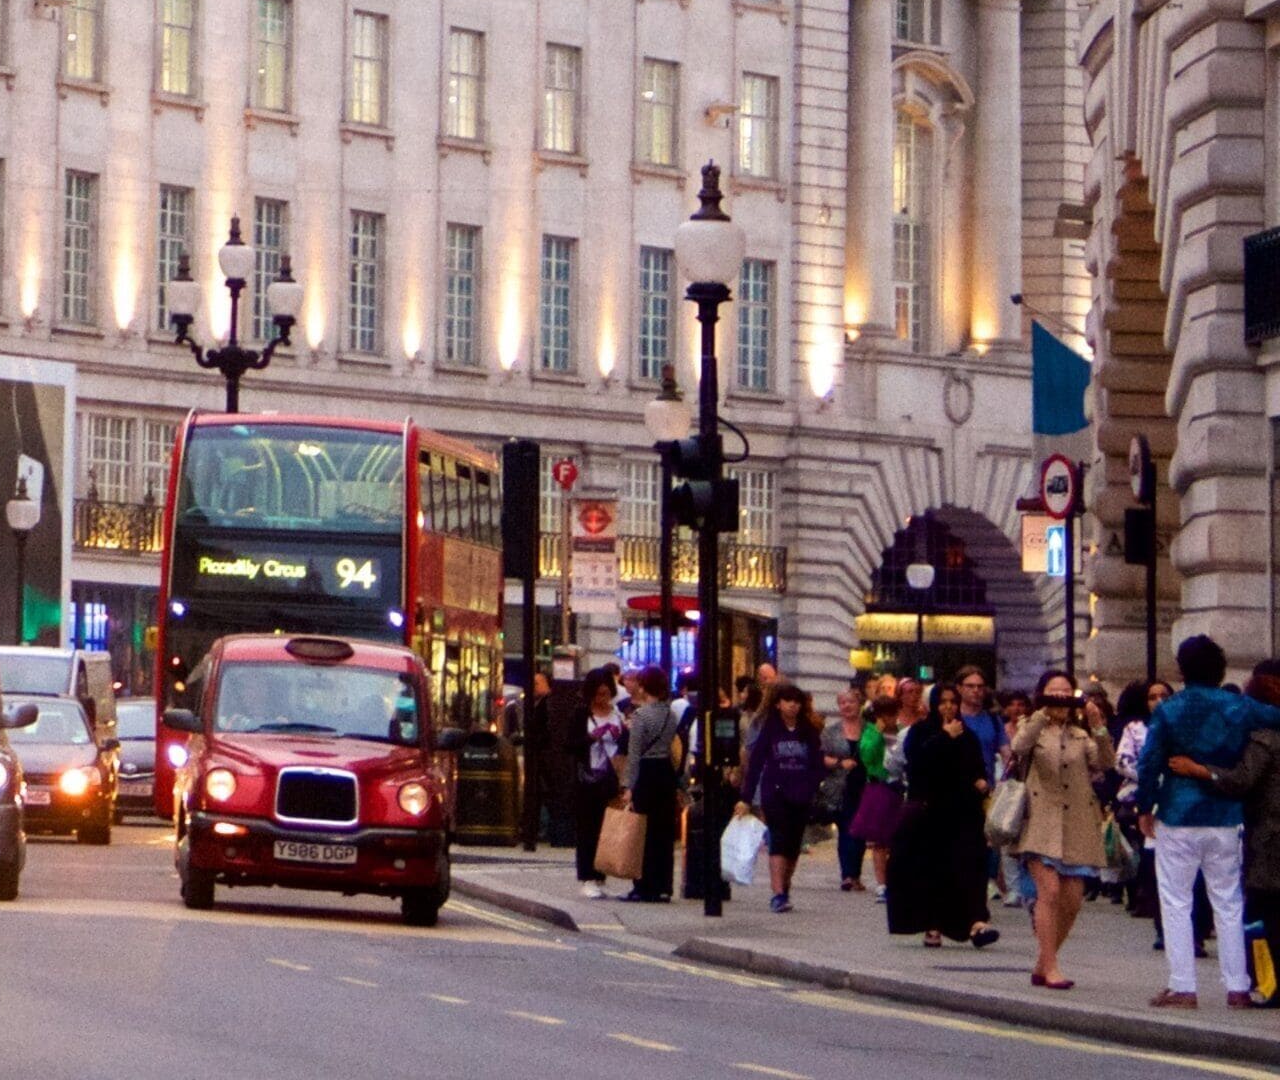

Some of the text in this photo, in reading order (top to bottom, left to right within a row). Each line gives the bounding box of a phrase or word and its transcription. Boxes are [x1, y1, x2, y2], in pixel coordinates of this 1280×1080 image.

[559, 463, 571, 482] F
[199, 557, 376, 589] Piccadilly Circus 94
